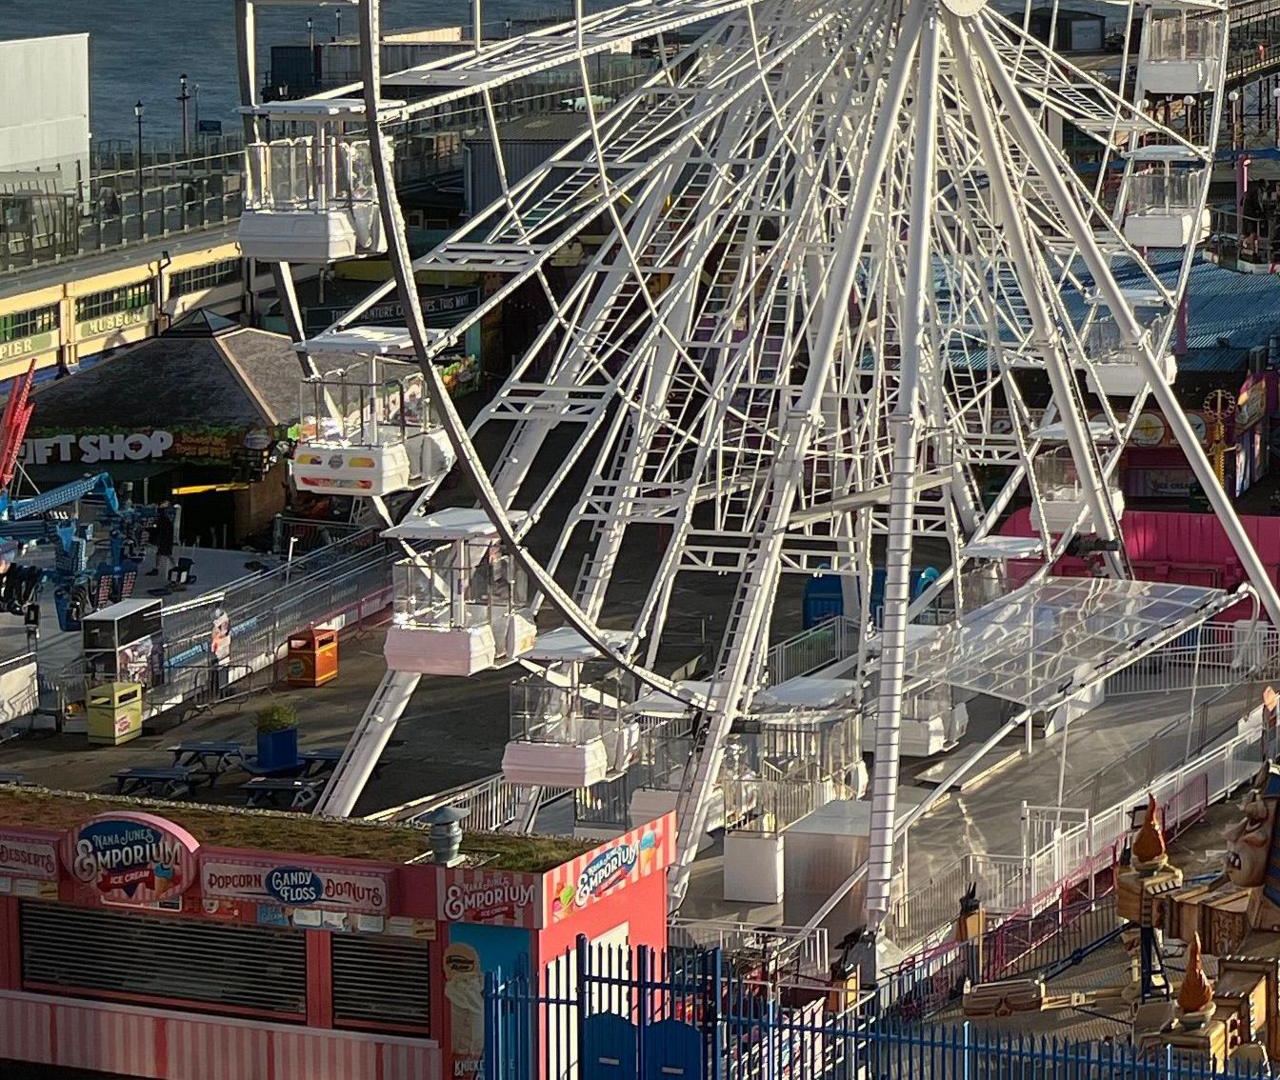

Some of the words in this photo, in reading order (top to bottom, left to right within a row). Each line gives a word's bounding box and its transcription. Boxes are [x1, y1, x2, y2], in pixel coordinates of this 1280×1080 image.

[79, 430, 174, 464] SHOP
[0, 842, 55, 873] DESSERTS
[72, 838, 182, 884] EMPORIUM
[574, 838, 640, 908] EMPORIUM
[110, 874, 124, 885] ICE
[124, 870, 150, 883] CREAM
[208, 872, 262, 889] POPCORN
[271, 871, 313, 891] CANDY
[280, 886, 316, 902] FLOSS
[445, 883, 536, 920] EMPORIUM
